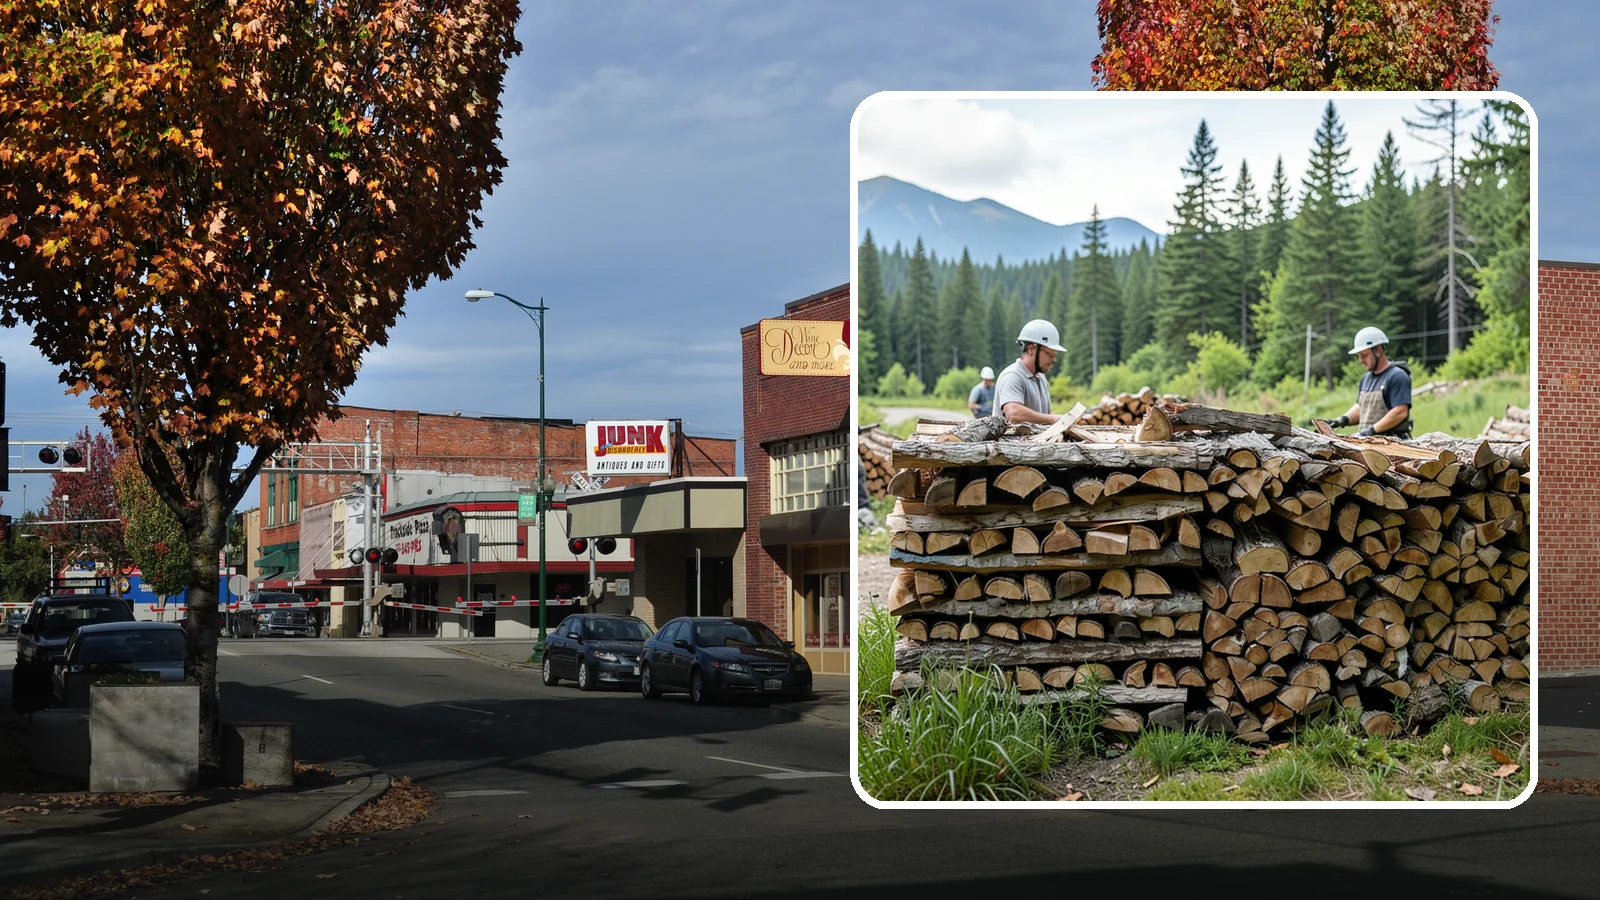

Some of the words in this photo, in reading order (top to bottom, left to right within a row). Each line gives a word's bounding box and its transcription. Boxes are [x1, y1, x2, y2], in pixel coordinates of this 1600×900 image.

[596, 425, 664, 457] JUNK
[608, 446, 646, 454] DISORDERLY
[597, 461, 628, 470] ANTIQUES
[631, 461, 644, 470] AND
[647, 461, 665, 469] GIFTS
[390, 521, 413, 540] Trackside
[414, 520, 429, 535] Pizza
